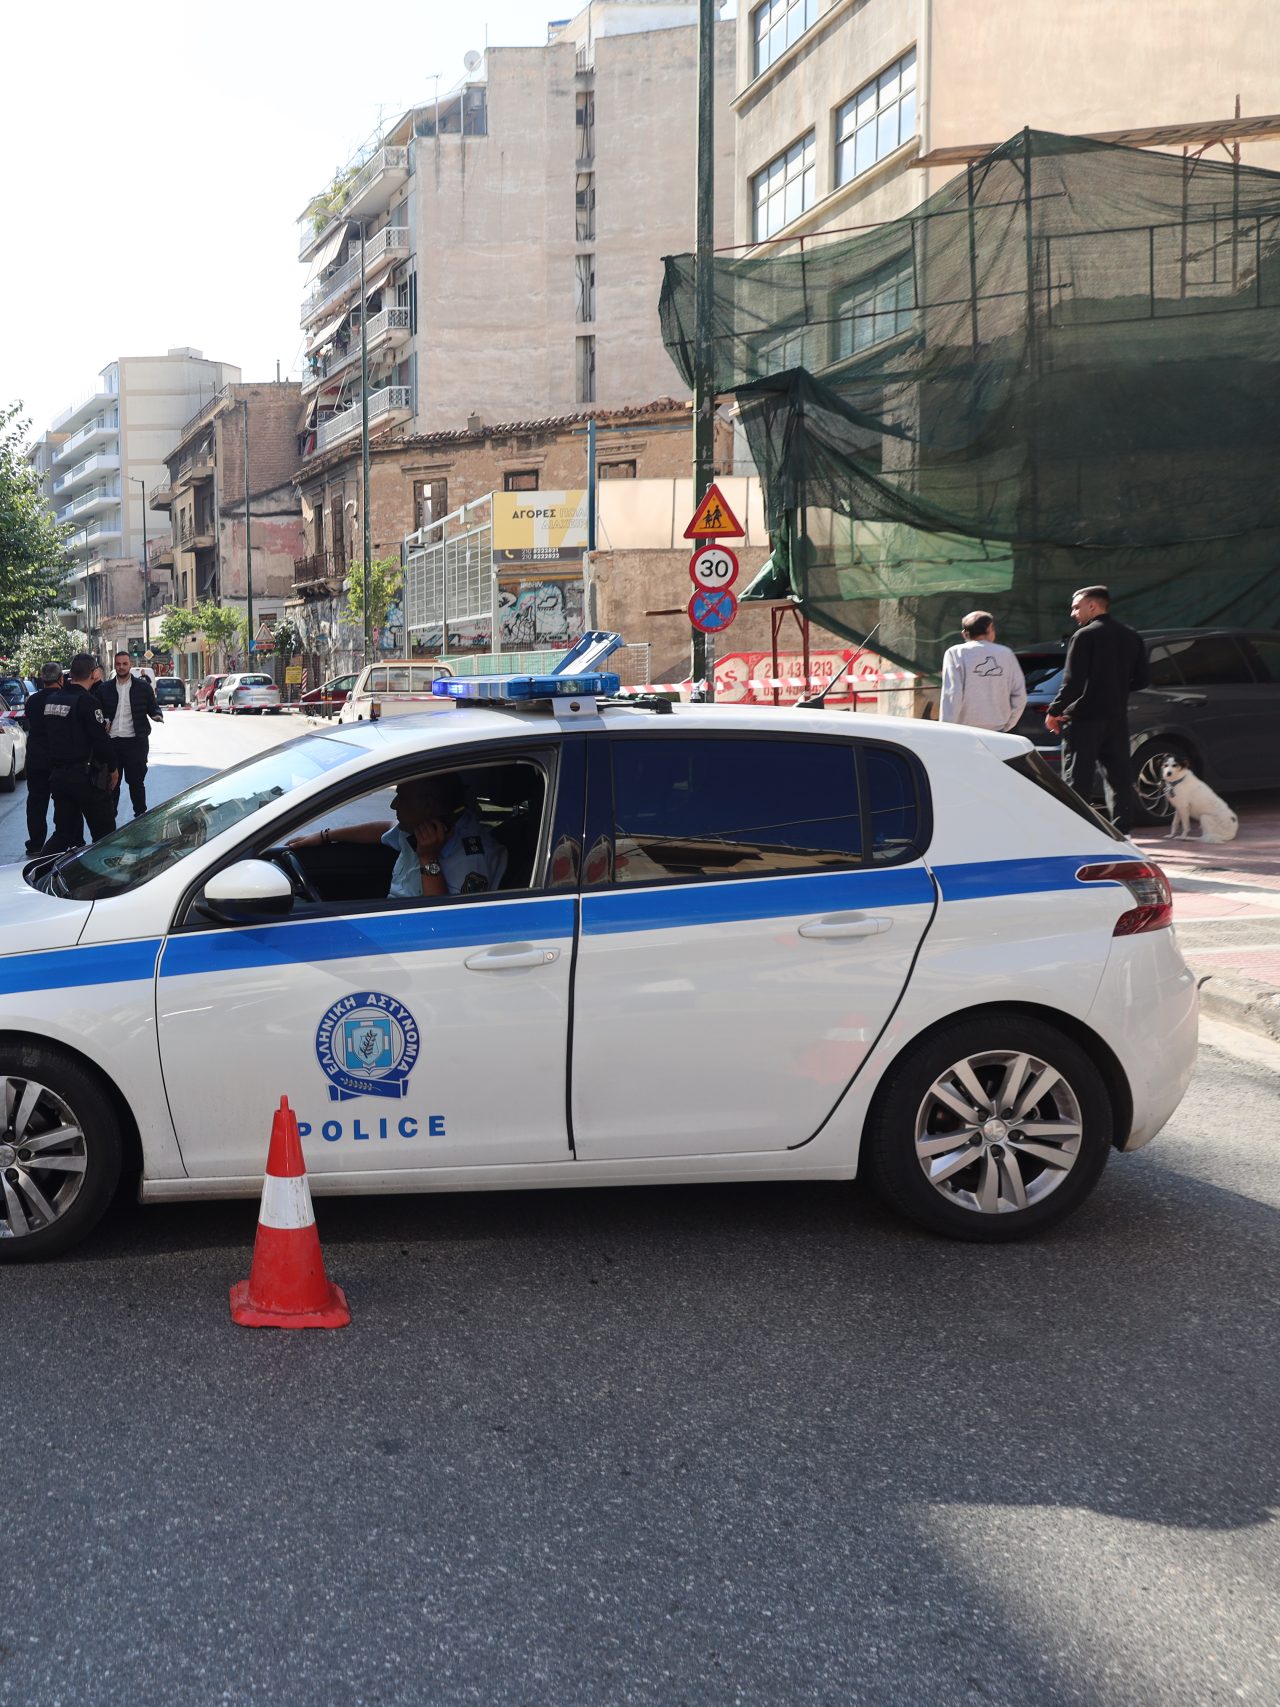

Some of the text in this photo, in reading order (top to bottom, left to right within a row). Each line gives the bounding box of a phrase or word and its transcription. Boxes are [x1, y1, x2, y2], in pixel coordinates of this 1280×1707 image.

[512, 508, 556, 519] ΑΓΟΡΕΣ
[700, 559, 729, 578] 30
[764, 662, 783, 679] 20
[318, 993, 418, 1076] ΕΛΛΗΝΙΚΗ ΑΣΤΥΝΟΜΙΑ
[297, 1115, 446, 1142] POLICE
